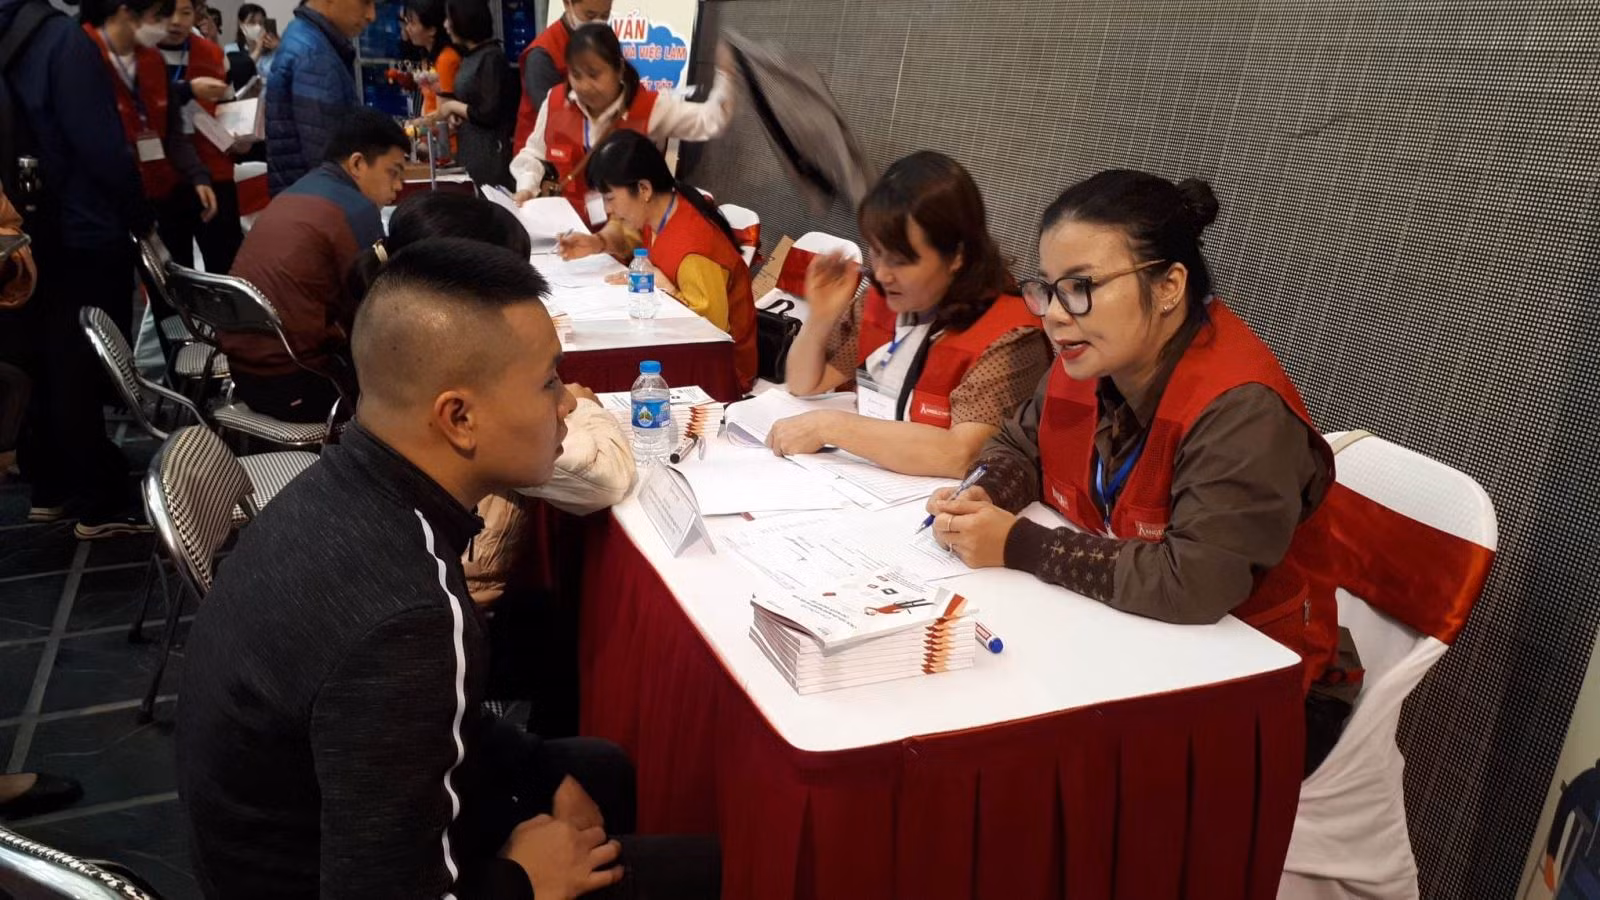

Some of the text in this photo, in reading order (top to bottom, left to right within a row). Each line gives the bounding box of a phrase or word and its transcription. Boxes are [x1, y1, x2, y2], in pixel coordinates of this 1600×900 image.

[613, 11, 646, 40] VẤN
[639, 43, 662, 62] VIỆC
[664, 44, 687, 60] LÀM
